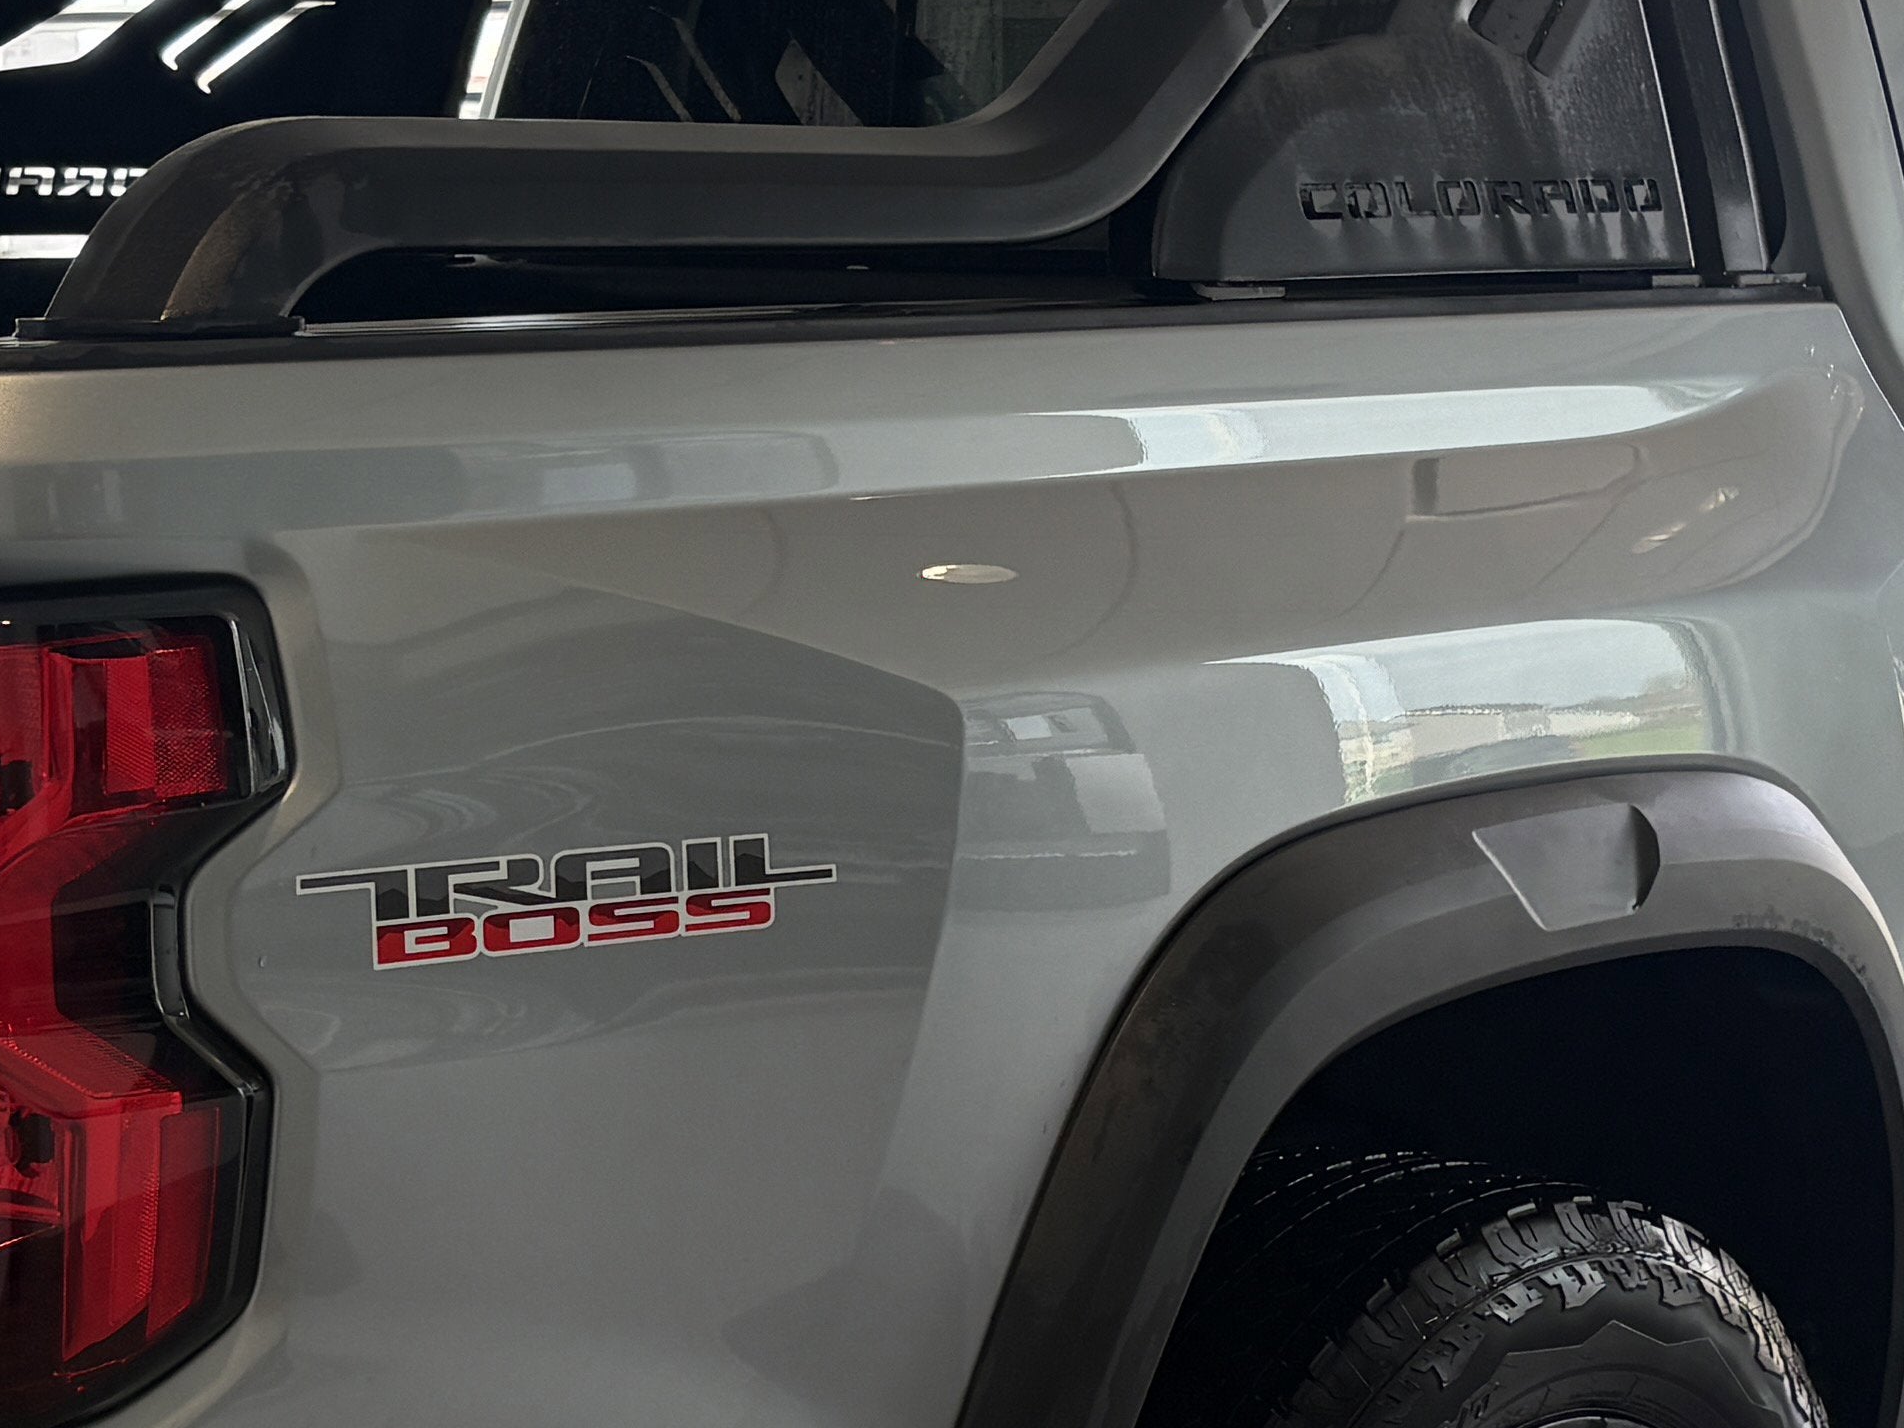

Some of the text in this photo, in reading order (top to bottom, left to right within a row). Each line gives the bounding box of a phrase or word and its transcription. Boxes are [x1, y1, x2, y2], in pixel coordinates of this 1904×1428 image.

[1298, 177, 1664, 221] COLORADO
[296, 833, 838, 922] TRAIL
[373, 887, 776, 971] BOSS
